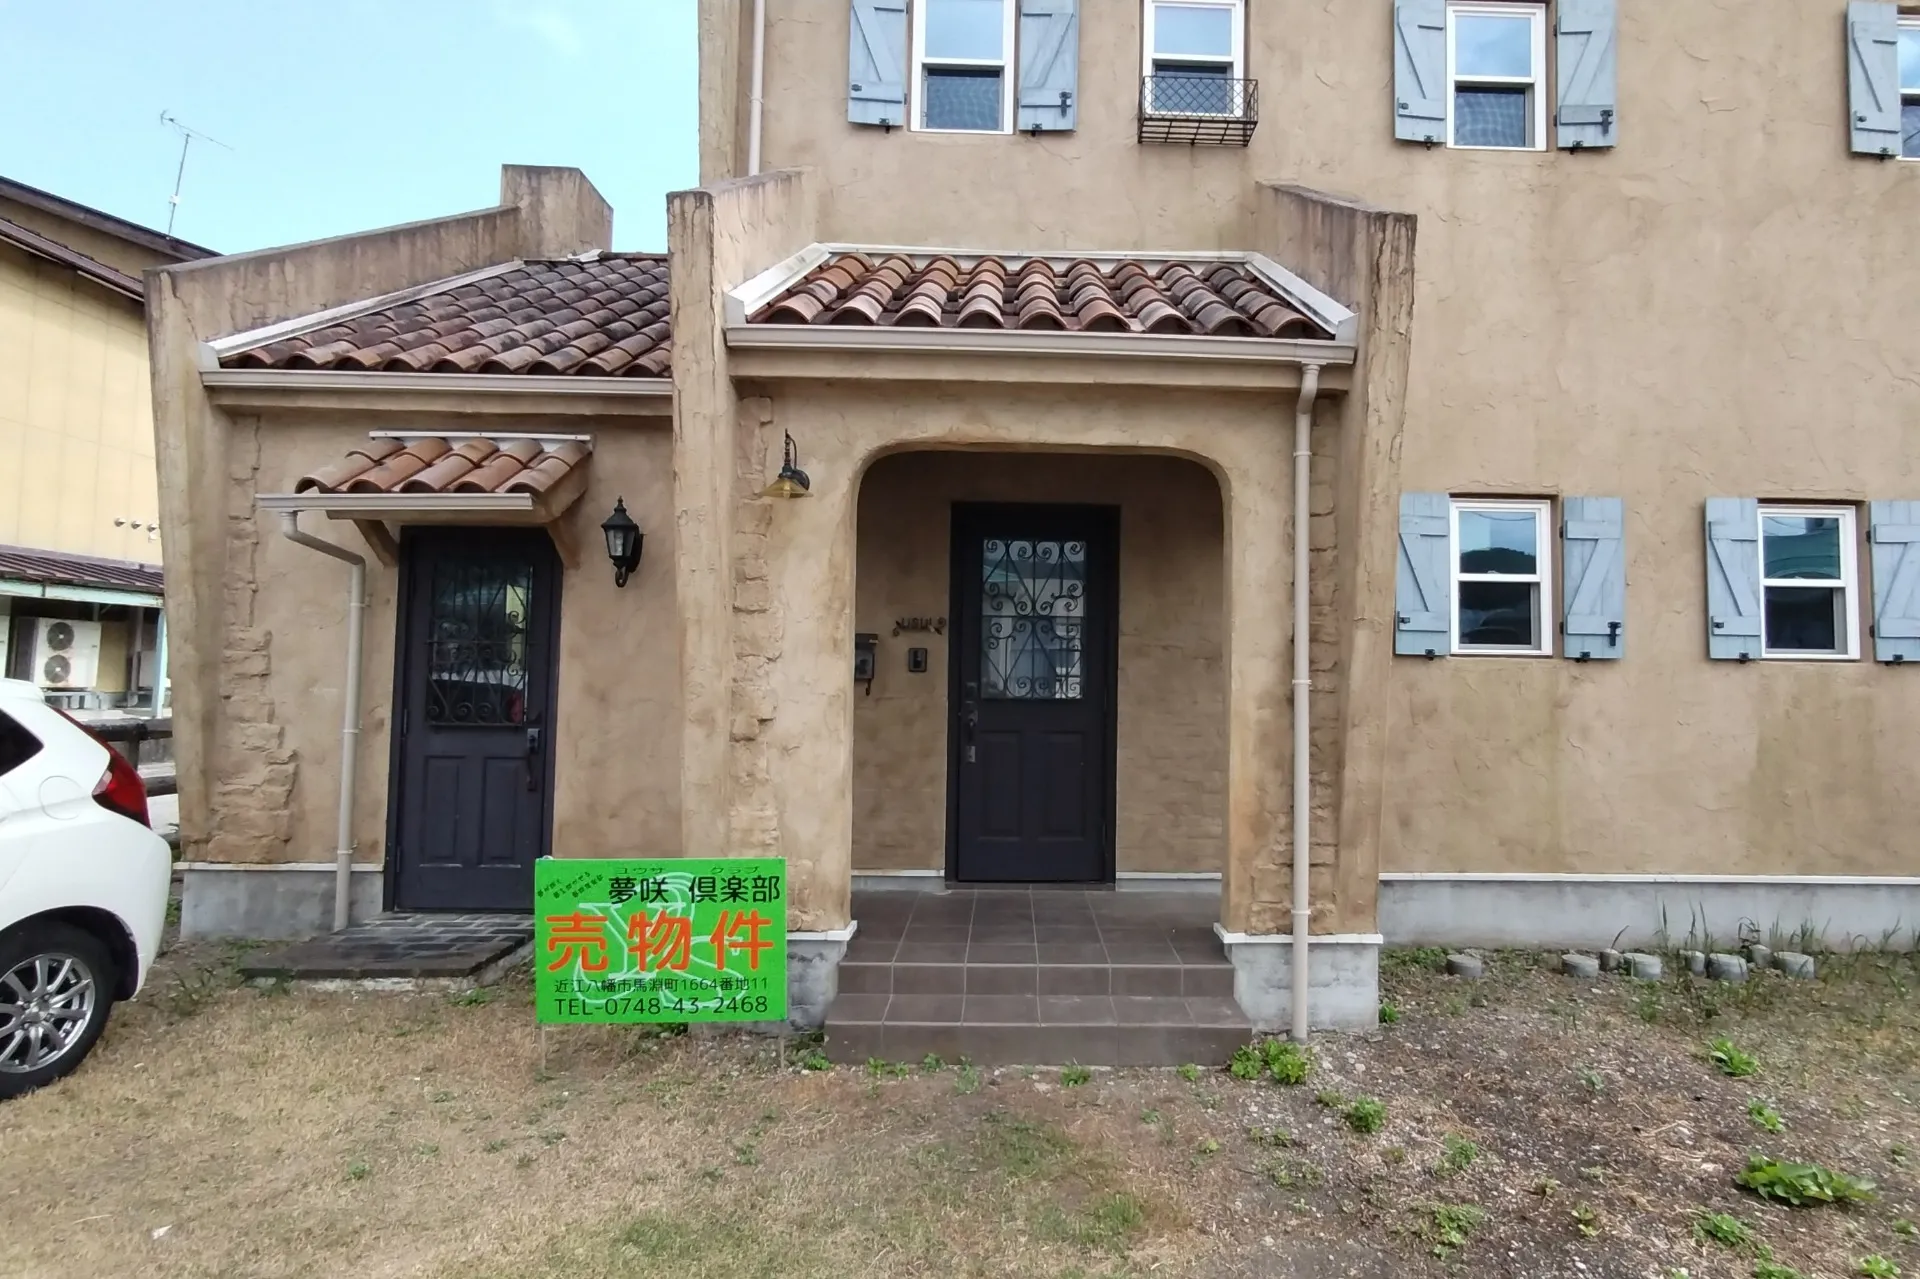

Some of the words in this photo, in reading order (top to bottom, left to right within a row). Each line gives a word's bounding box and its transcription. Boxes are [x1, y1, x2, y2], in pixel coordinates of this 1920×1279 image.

[608, 876, 669, 904] 夢咲
[688, 875, 780, 903] 倶楽部
[546, 910, 774, 972] 売物件
[554, 996, 768, 1015] TEL-0748-43-2468
